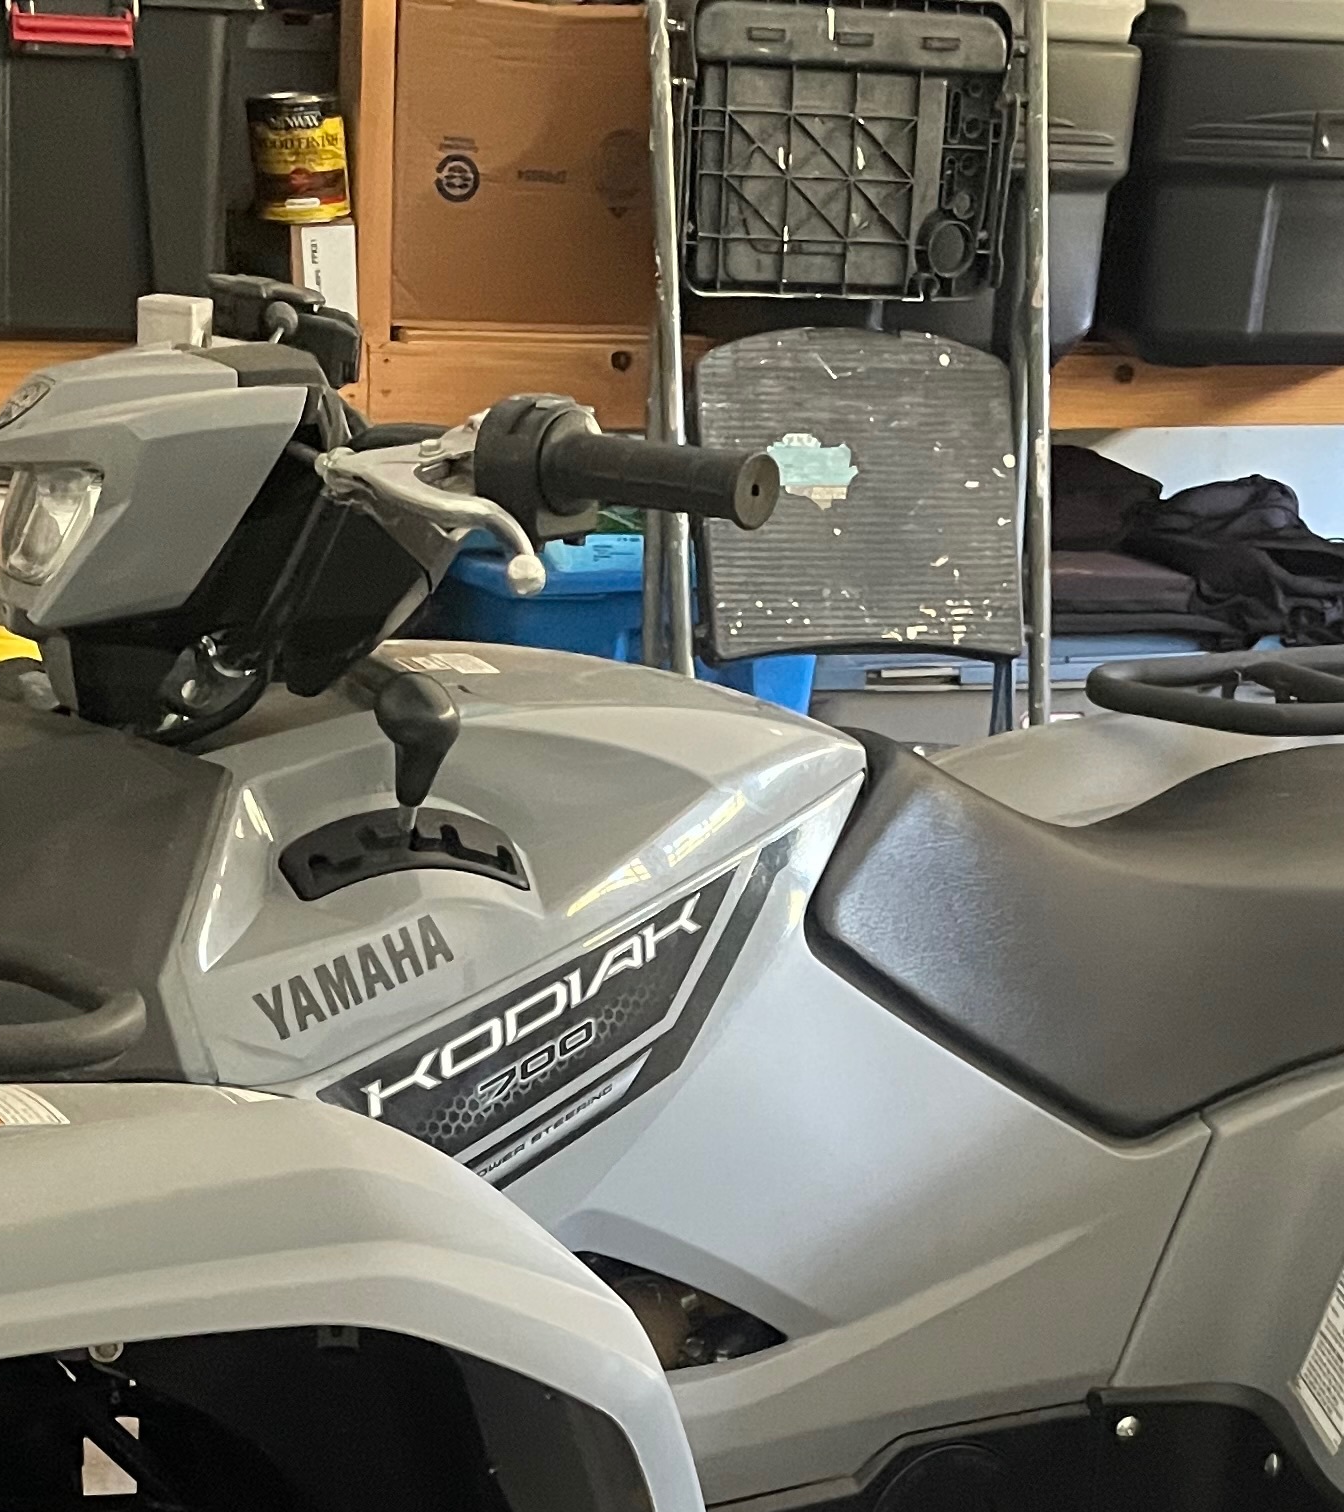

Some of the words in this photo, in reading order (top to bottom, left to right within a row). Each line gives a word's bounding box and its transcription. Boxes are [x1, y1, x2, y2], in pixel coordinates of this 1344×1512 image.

[252, 914, 454, 1041] YAMAHA
[360, 891, 704, 1119] KODIAK
[477, 1017, 597, 1112] 700
[476, 1142, 526, 1178] OWER
[530, 1082, 614, 1144] STEERING
